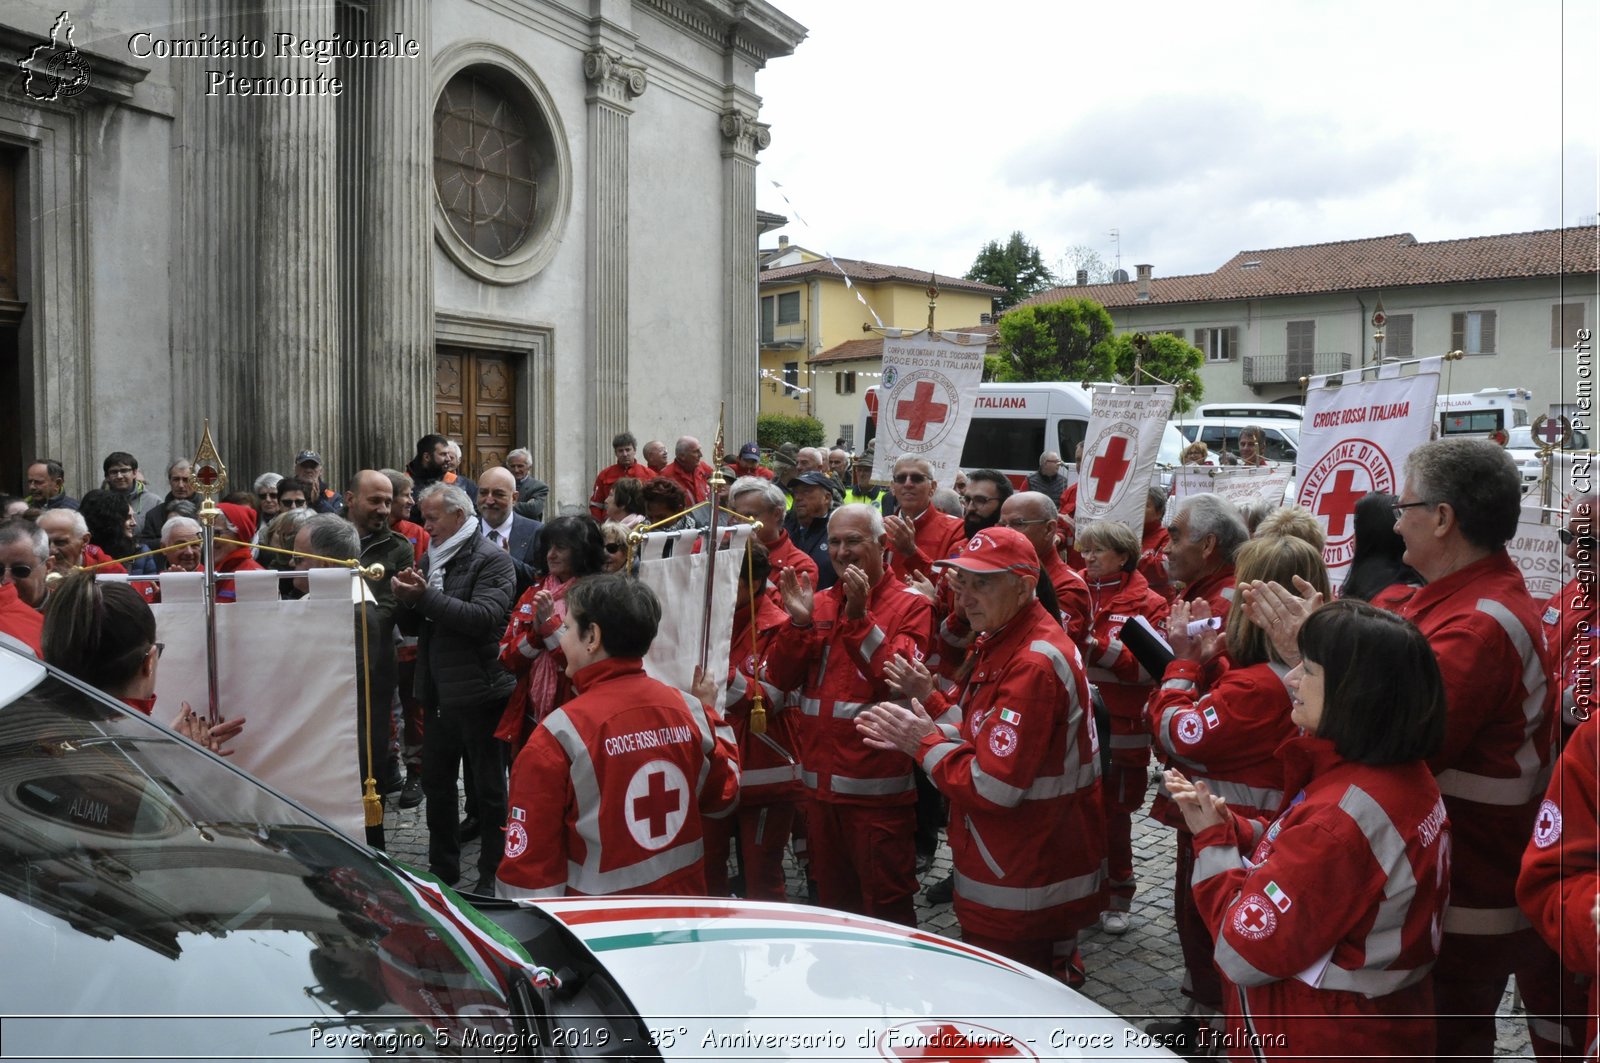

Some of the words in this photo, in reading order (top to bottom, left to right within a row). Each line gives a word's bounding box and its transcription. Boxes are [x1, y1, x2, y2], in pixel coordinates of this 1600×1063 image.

[883, 355, 911, 365] CROCE
[912, 358, 940, 368] ROSSA
[942, 360, 982, 370] ITALIANA
[936, 349, 947, 358] DEL
[974, 397, 1027, 409] ITALIANA
[1312, 410, 1341, 428] CROCE
[1341, 406, 1367, 424] ROSSA
[1368, 401, 1410, 422] ITALIANA
[1301, 443, 1355, 507] ONVENZIONE
[1357, 445, 1374, 463] DI
[1369, 456, 1391, 495] GINEV
[605, 733, 636, 756] CROCE
[634, 729, 660, 750] ROSSA
[659, 725, 692, 746] ITALIANA
